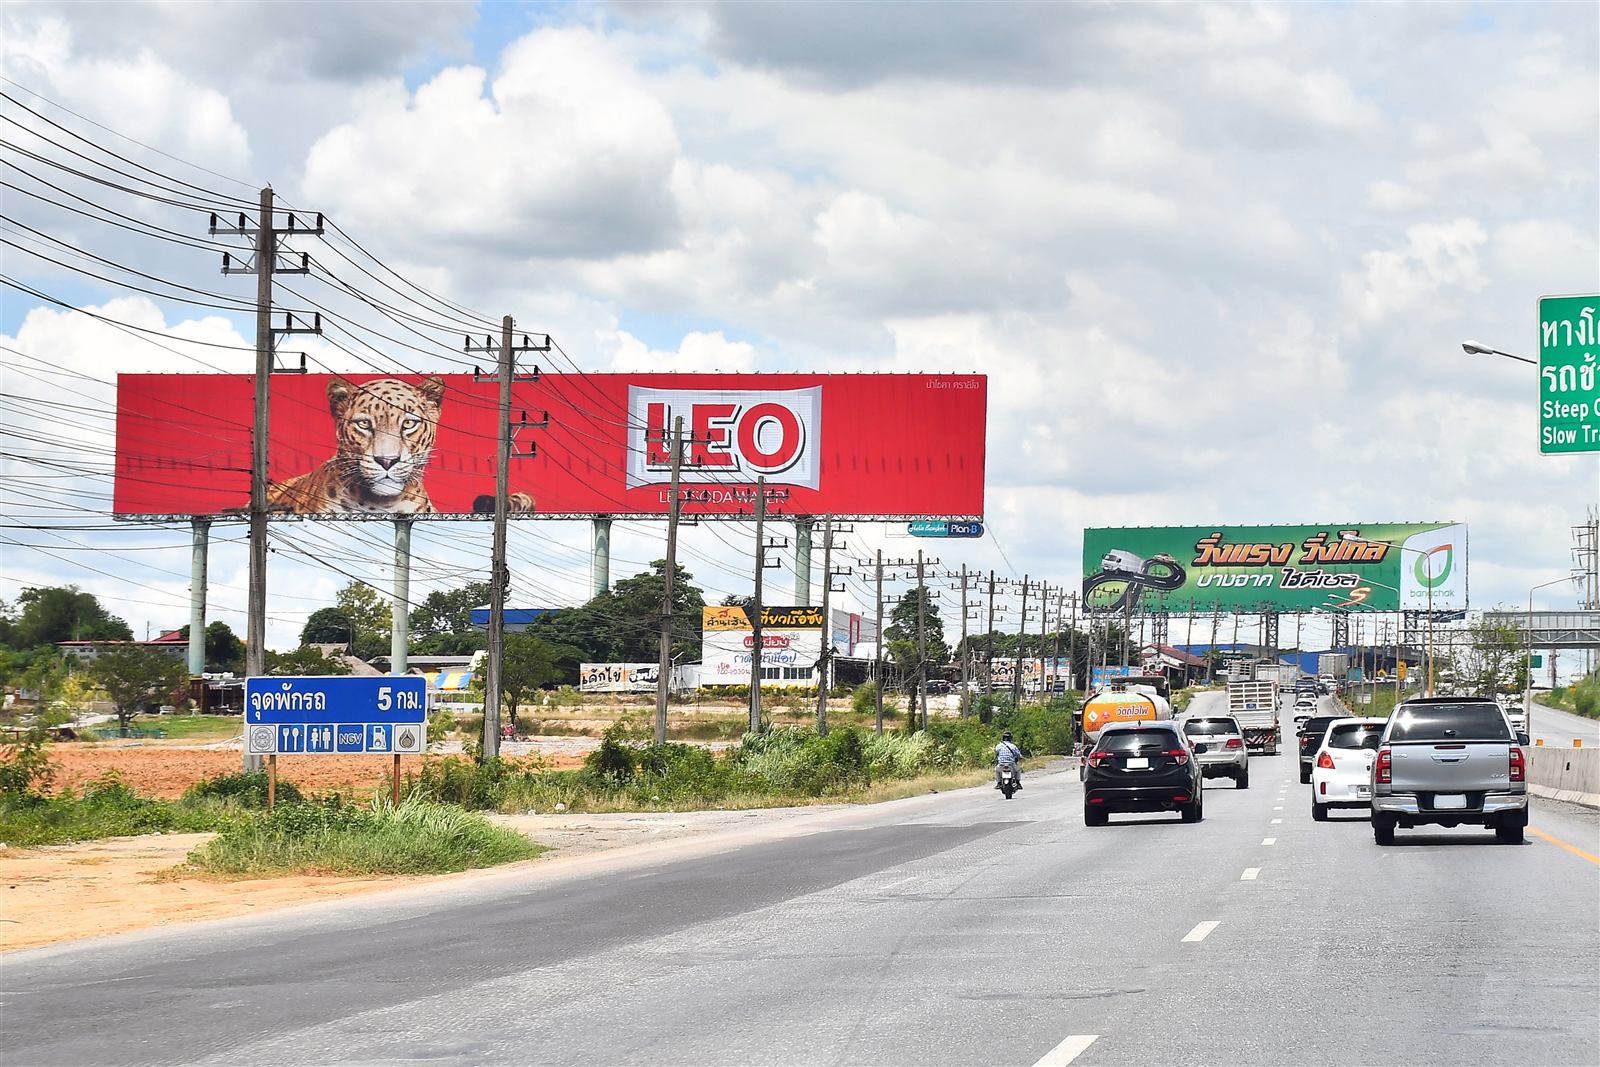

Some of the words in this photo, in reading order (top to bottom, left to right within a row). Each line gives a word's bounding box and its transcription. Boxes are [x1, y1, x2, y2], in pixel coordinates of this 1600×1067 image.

[1541, 306, 1600, 347] ทางโ
[1541, 352, 1600, 392] รถช้
[1543, 400, 1589, 421] Steep
[647, 402, 806, 475] LEO
[1543, 426, 1577, 444] Slow
[1582, 424, 1600, 443] Tr
[735, 491, 785, 503] WAER
[1193, 532, 1294, 564] วิ่งแรง
[1197, 574, 1274, 587] บางจาก
[1410, 590, 1455, 599] banchak
[251, 683, 326, 720] จุดพักรถ
[377, 687, 392, 711] 5
[396, 692, 422, 709] กม.
[339, 733, 362, 744] NGV
